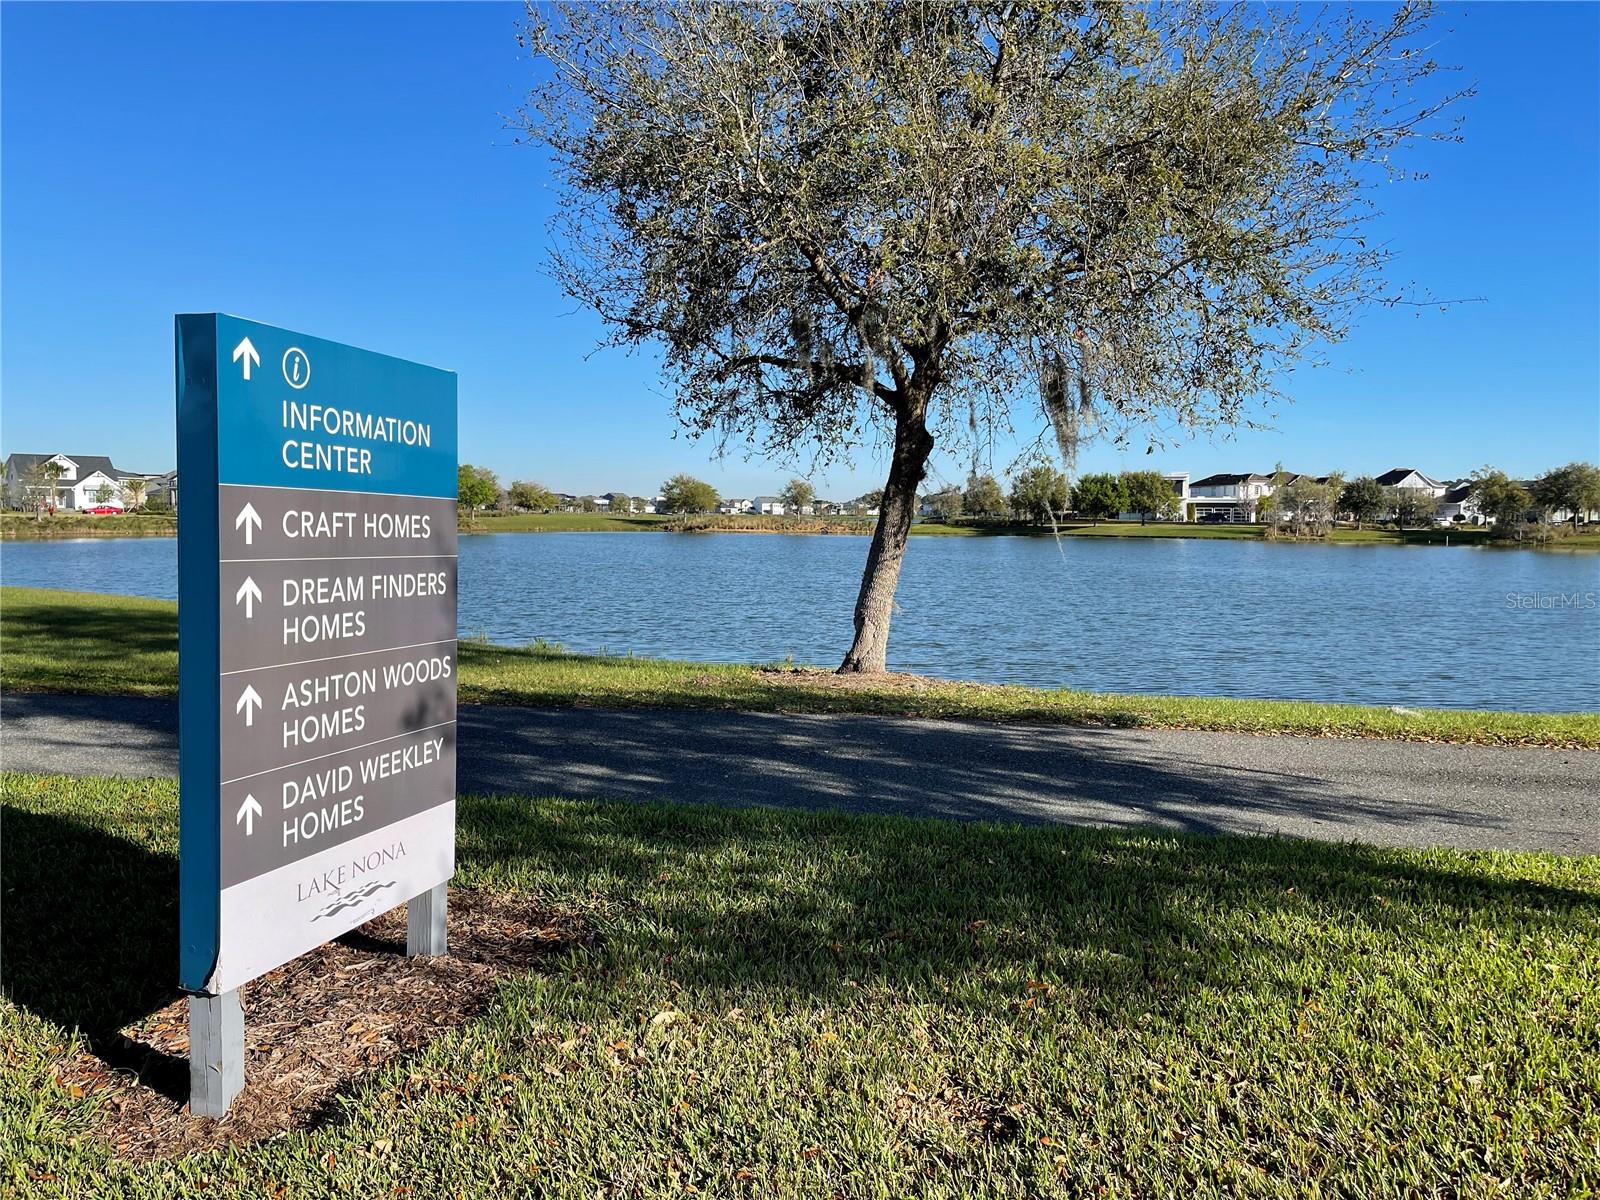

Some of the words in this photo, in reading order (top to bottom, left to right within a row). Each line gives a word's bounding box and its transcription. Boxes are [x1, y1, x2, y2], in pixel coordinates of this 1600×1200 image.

[282, 400, 431, 447] INFORMATION
[282, 440, 371, 474] CENTER
[282, 510, 357, 538] CRAFT
[364, 513, 431, 539] HOMES
[283, 576, 364, 606] DREAM
[372, 572, 447, 599] FINDERS
[283, 611, 366, 645] HOMES
[281, 668, 376, 711] ASHTON
[383, 655, 451, 690] WOODS
[283, 705, 365, 748] HOMES
[282, 765, 353, 809] DAVID
[359, 737, 444, 784] WEEKLEY
[283, 795, 364, 848] HOMES
[296, 865, 346, 902] LAKE
[352, 842, 406, 878] NONA
